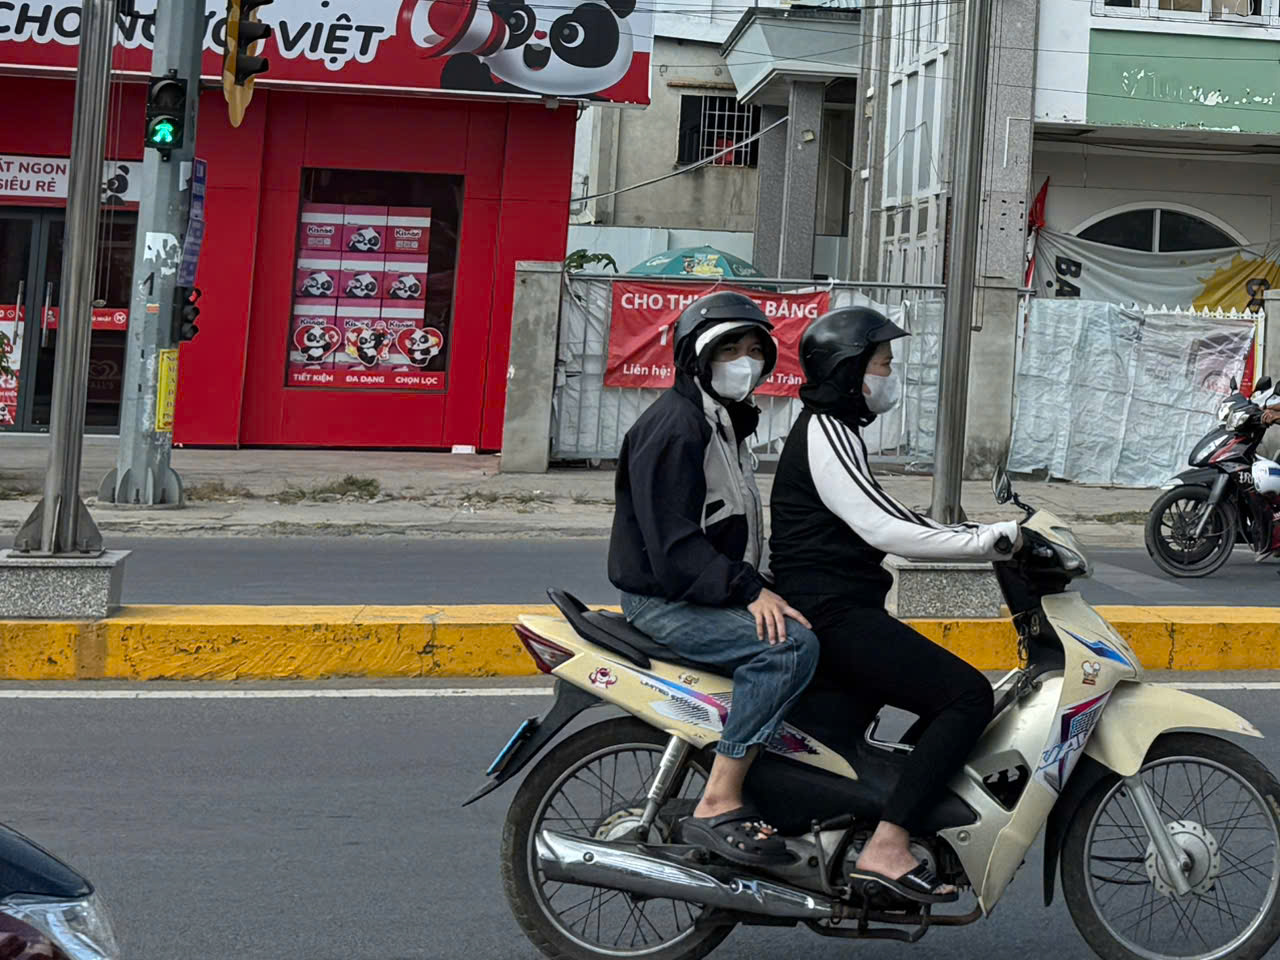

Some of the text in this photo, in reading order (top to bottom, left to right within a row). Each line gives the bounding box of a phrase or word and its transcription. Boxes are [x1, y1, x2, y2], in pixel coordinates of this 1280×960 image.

[279, 13, 385, 63] VIỆT
[18, 161, 67, 176] NGON
[620, 292, 663, 311] CHO
[623, 364, 649, 376] Liên
[421, 376, 438, 385] LỌC
